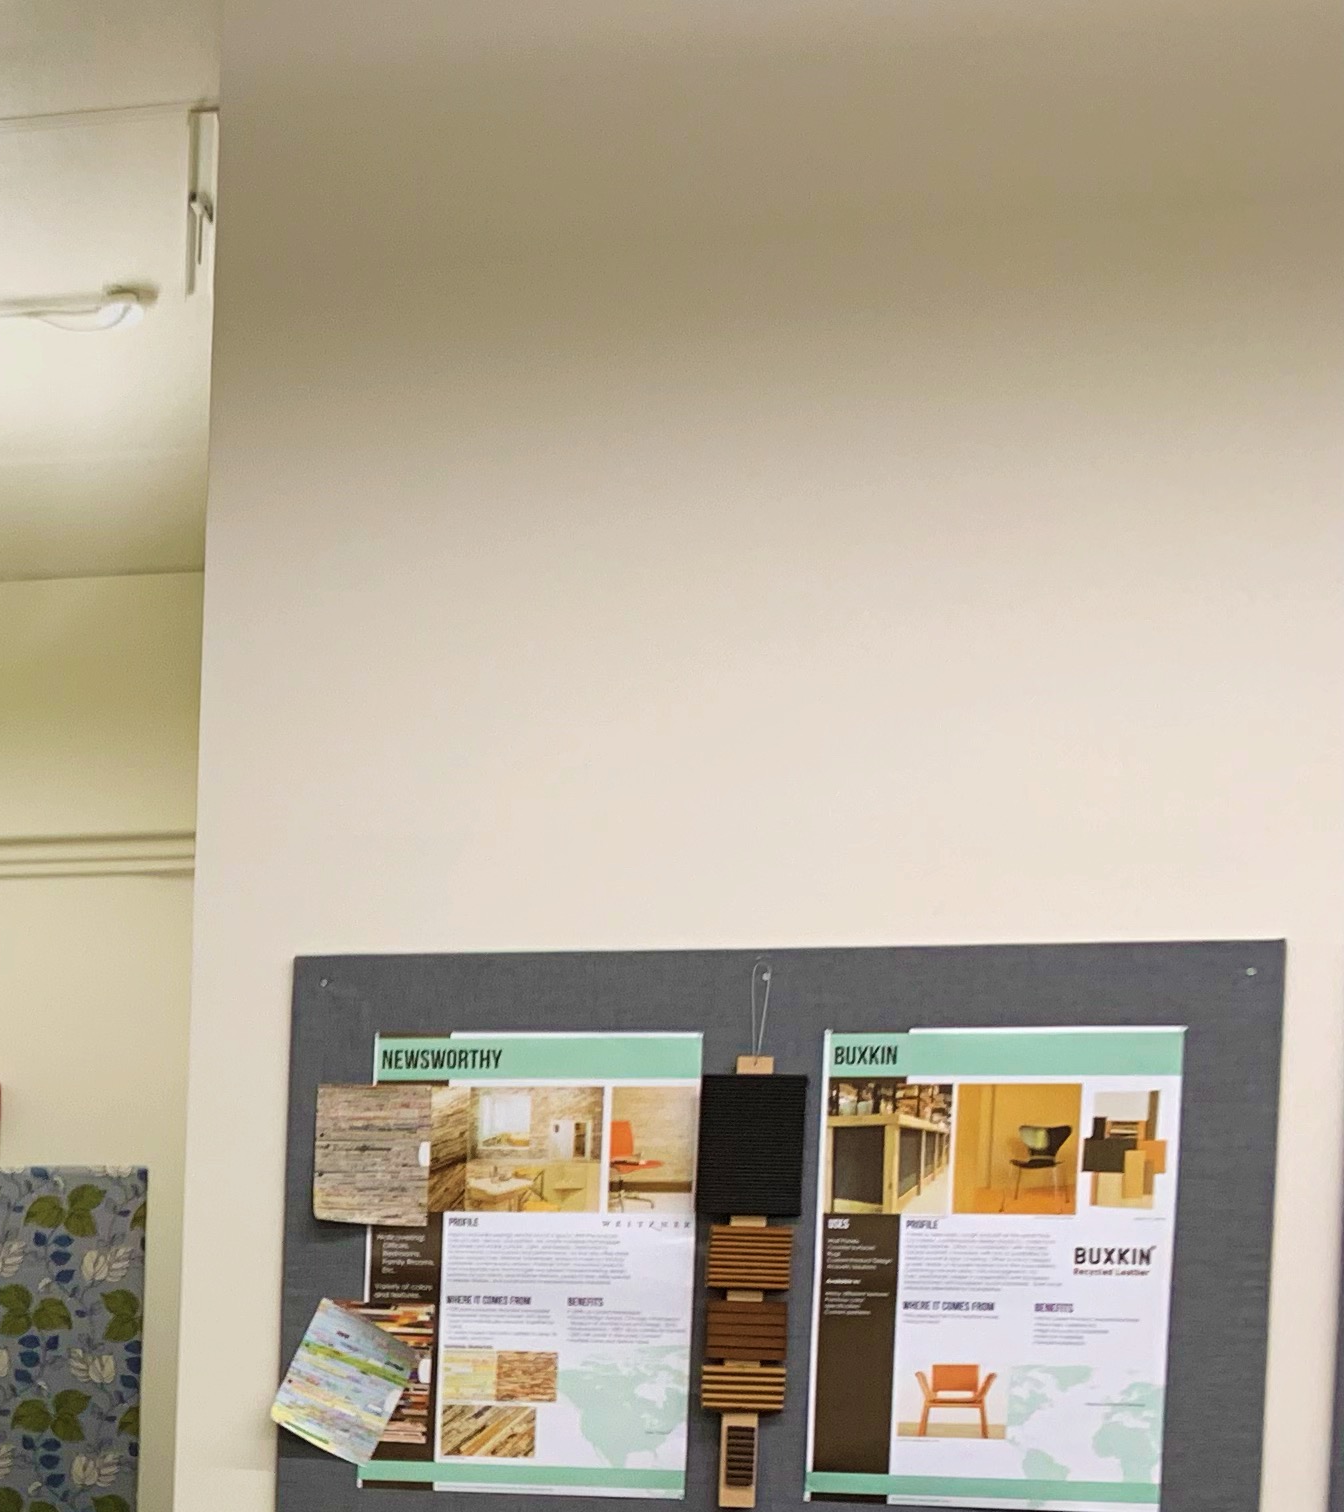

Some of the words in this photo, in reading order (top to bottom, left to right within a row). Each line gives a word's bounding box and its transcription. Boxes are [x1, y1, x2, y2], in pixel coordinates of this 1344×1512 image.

[381, 1049, 503, 1070] NEWSWORTHY
[834, 1045, 899, 1066] BUXKIN
[448, 1218, 479, 1227] PROFILE
[906, 1220, 938, 1229] PROFILE
[1073, 1247, 1152, 1266] BUXKIN
[446, 1296, 472, 1306] WHERE
[483, 1297, 508, 1306] COMES
[510, 1297, 532, 1306] FROM
[566, 1298, 604, 1307] BENEFITS
[903, 1302, 930, 1311] WHERE
[942, 1302, 970, 1311] COMES
[972, 1302, 995, 1312] FROM
